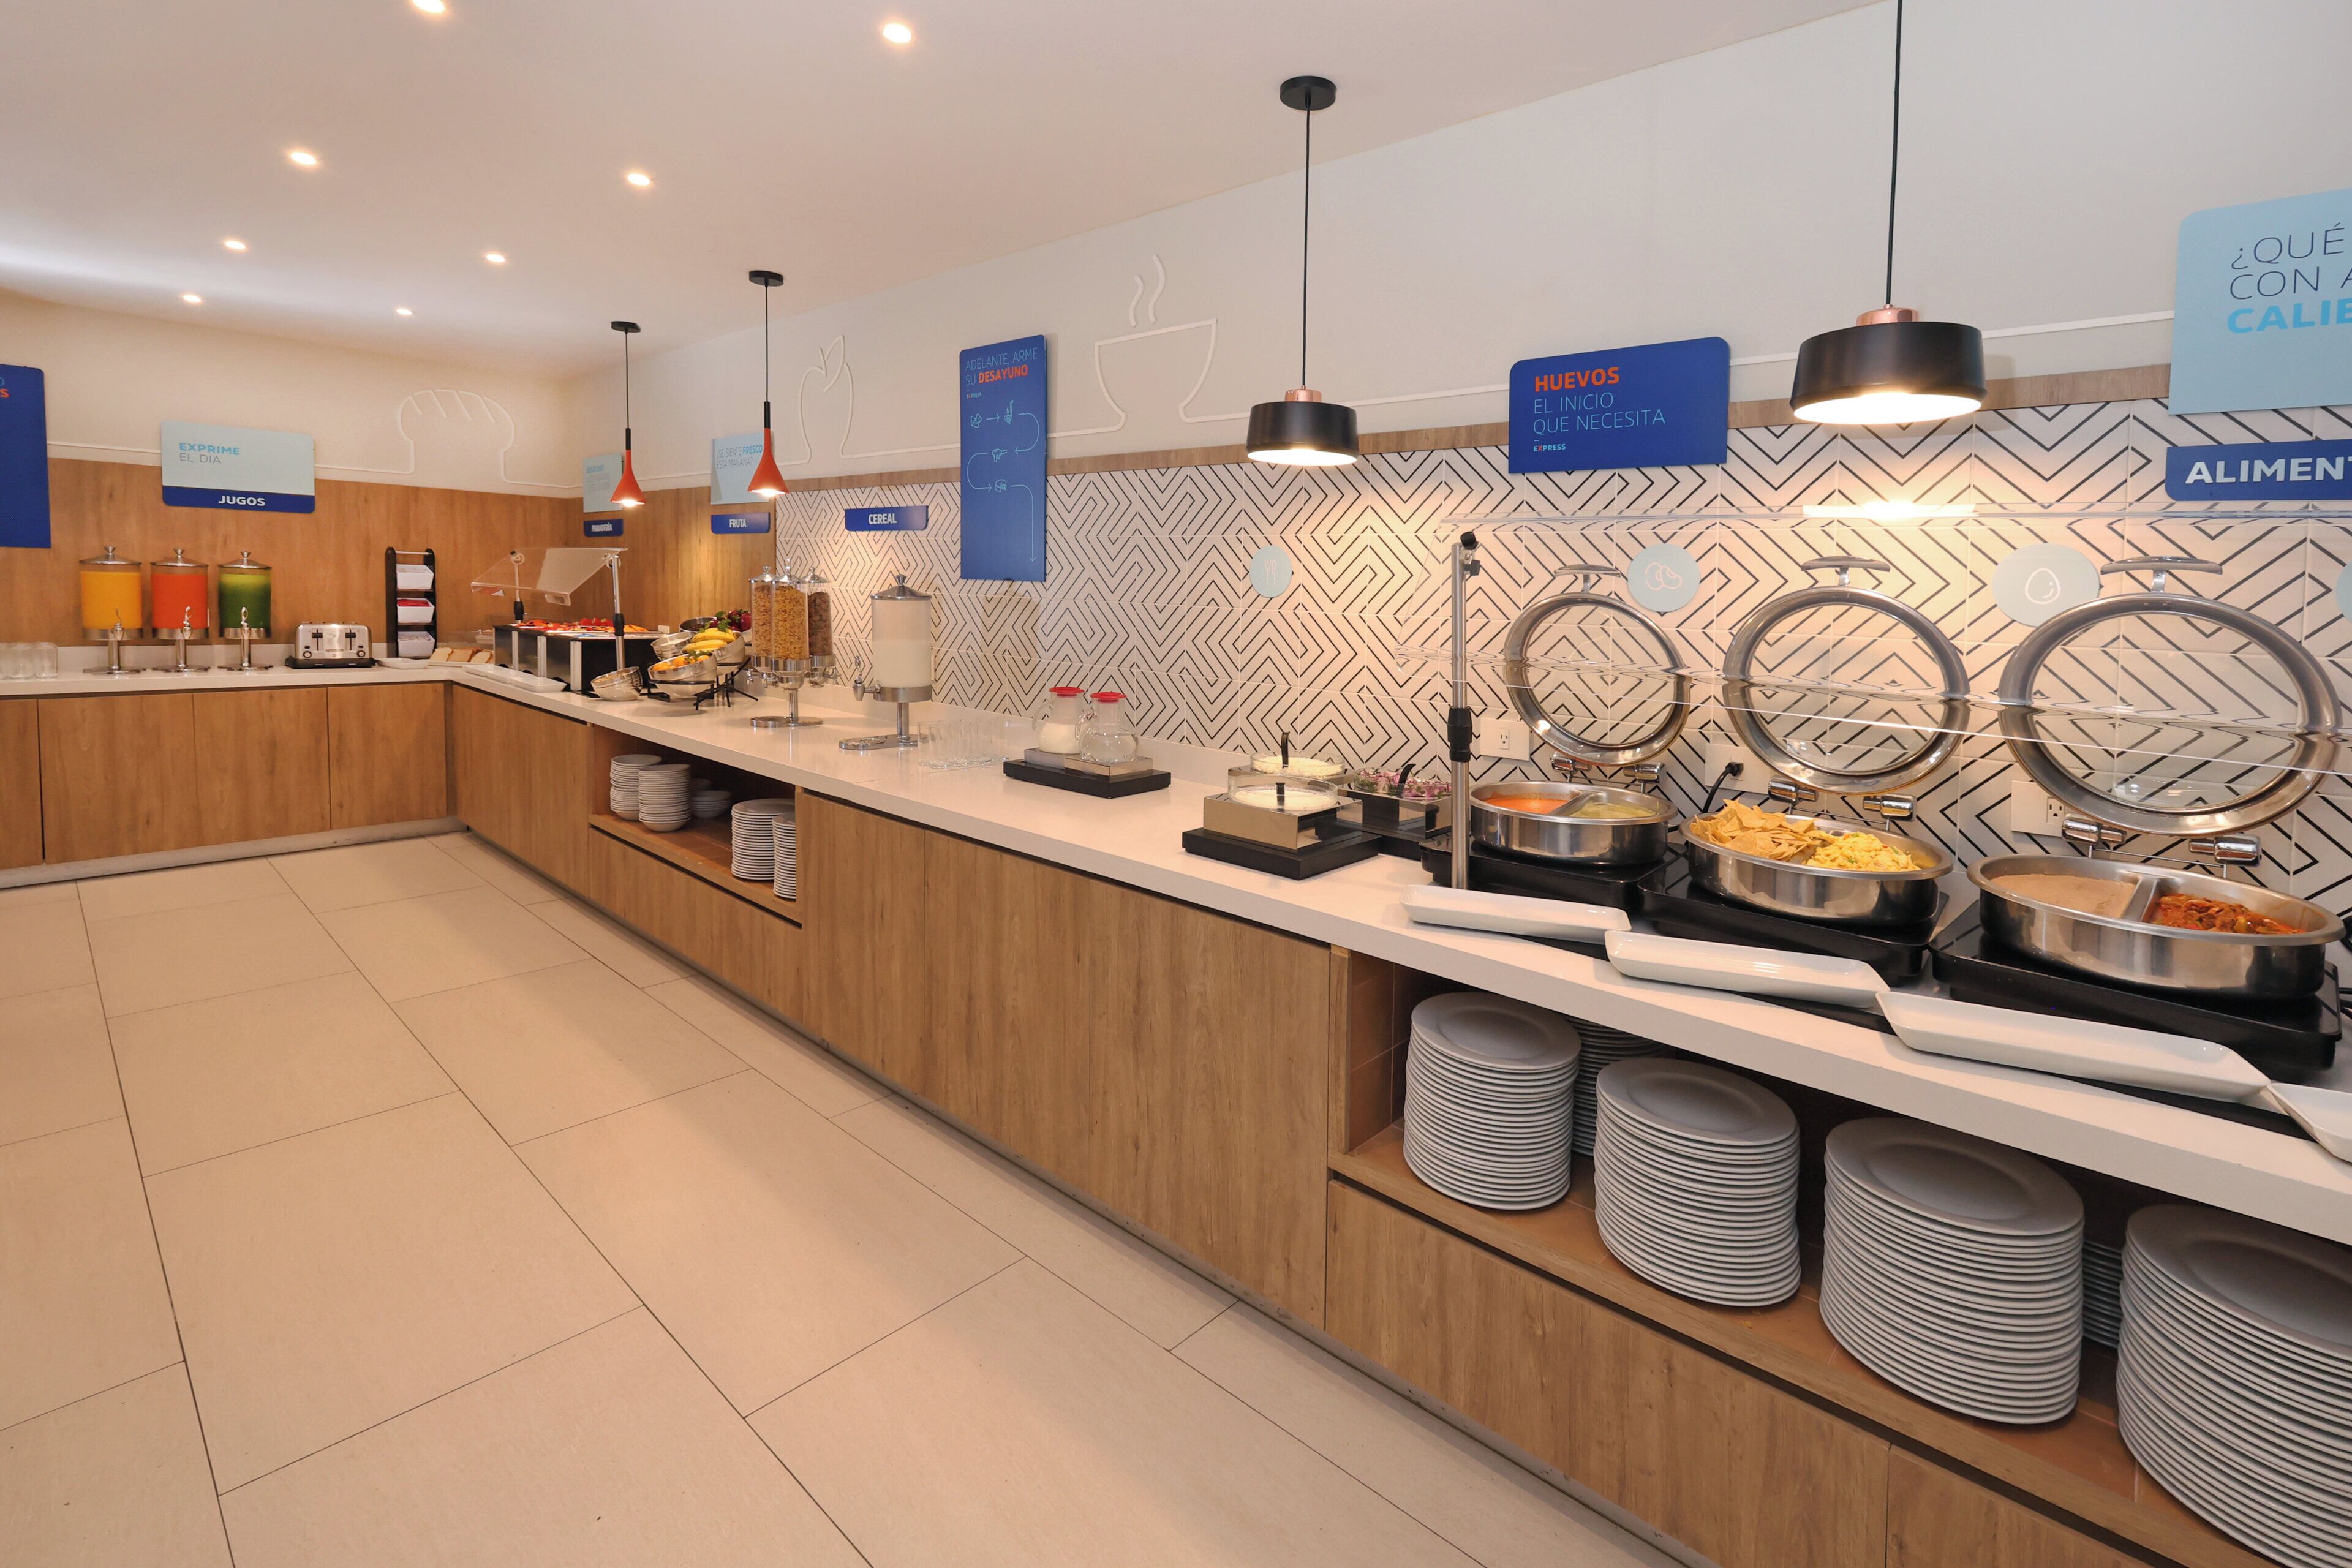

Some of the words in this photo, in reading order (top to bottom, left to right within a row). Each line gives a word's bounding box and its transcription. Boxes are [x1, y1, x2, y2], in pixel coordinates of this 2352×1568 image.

[2231, 222, 2345, 270] ¿QUÉ
[2230, 266, 2320, 300] CON
[965, 353, 1009, 371] ADELANTE,
[1012, 347, 1038, 363] ARME
[965, 374, 976, 386] SU
[978, 364, 1028, 383] DESAYUNO
[1534, 366, 1620, 393] HUEVOS
[1534, 399, 1553, 414] EL
[1560, 392, 1613, 412] INICIO
[1533, 417, 1569, 435] QUE
[1577, 409, 1665, 431] NECESITA
[179, 443, 241, 456] EXPRIME
[742, 445, 763, 455] FRESCO
[1533, 443, 1566, 452] EXPRESS
[179, 453, 194, 462] EL
[199, 454, 222, 464] DIA
[218, 495, 266, 507] JUGOS
[729, 519, 747, 528] FRUTA
[868, 513, 897, 524] CEREAL
